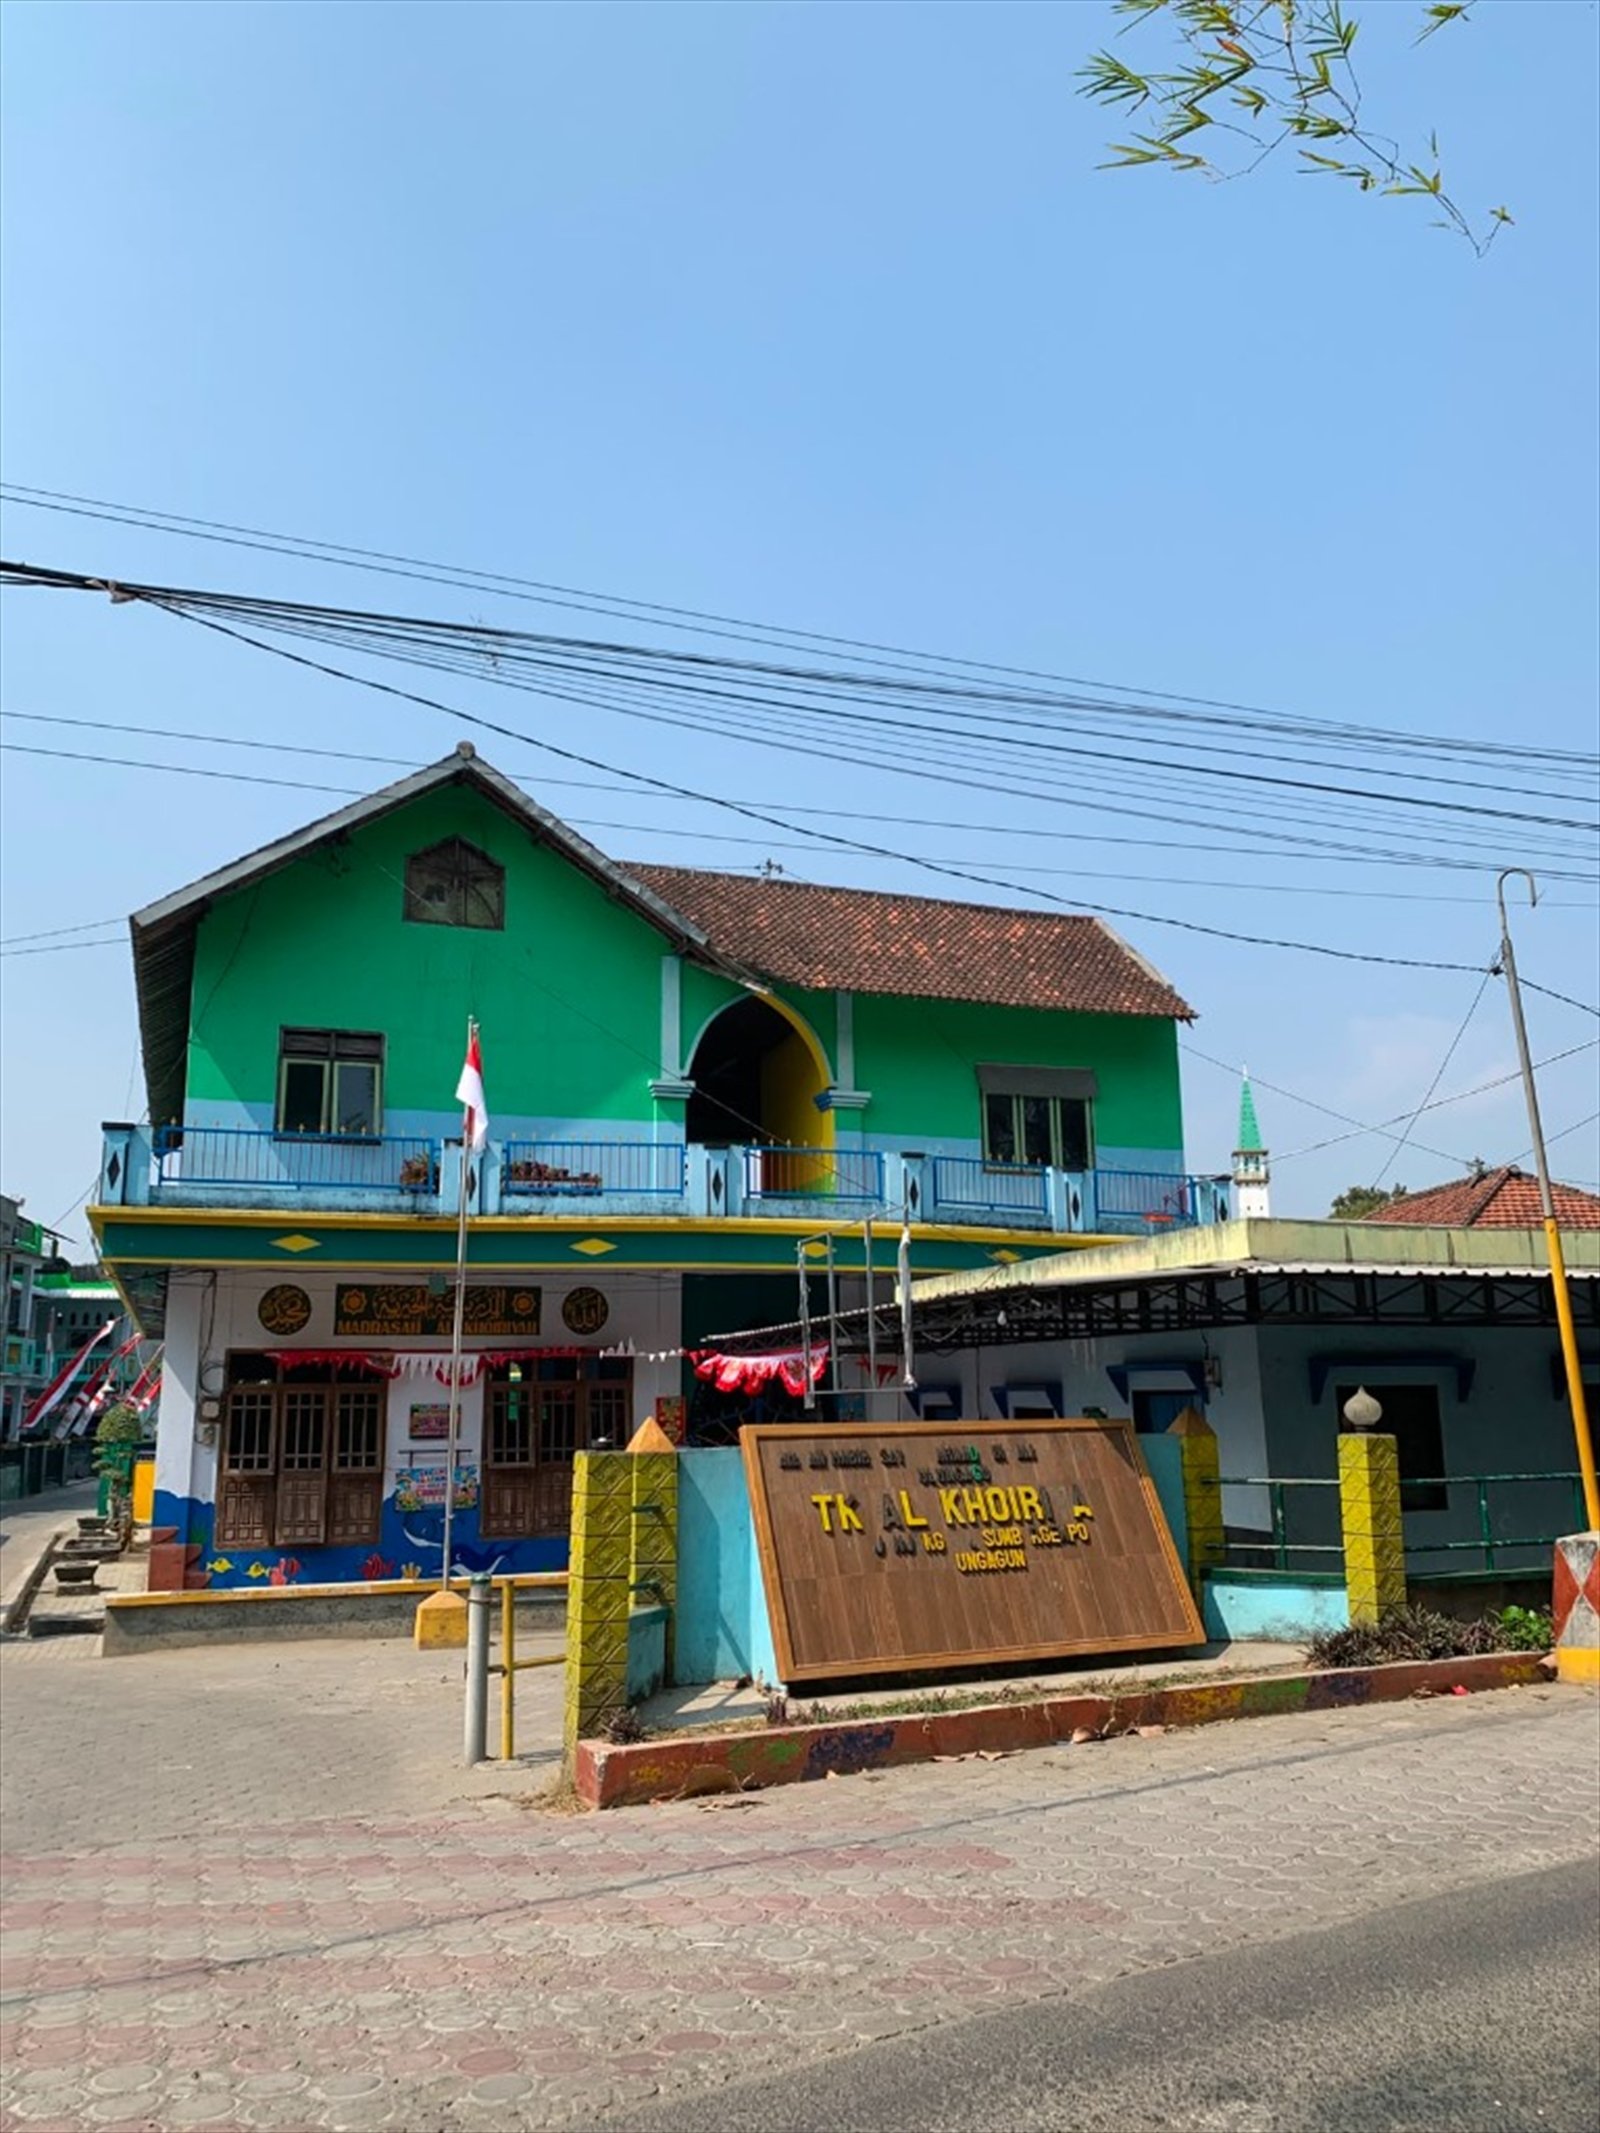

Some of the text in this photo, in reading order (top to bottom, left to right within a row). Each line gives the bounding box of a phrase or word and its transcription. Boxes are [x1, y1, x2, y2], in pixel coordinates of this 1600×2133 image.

[337, 1320, 422, 1334] MADRASAH
[810, 1493, 864, 1532] TK
[883, 1490, 929, 1531] AL
